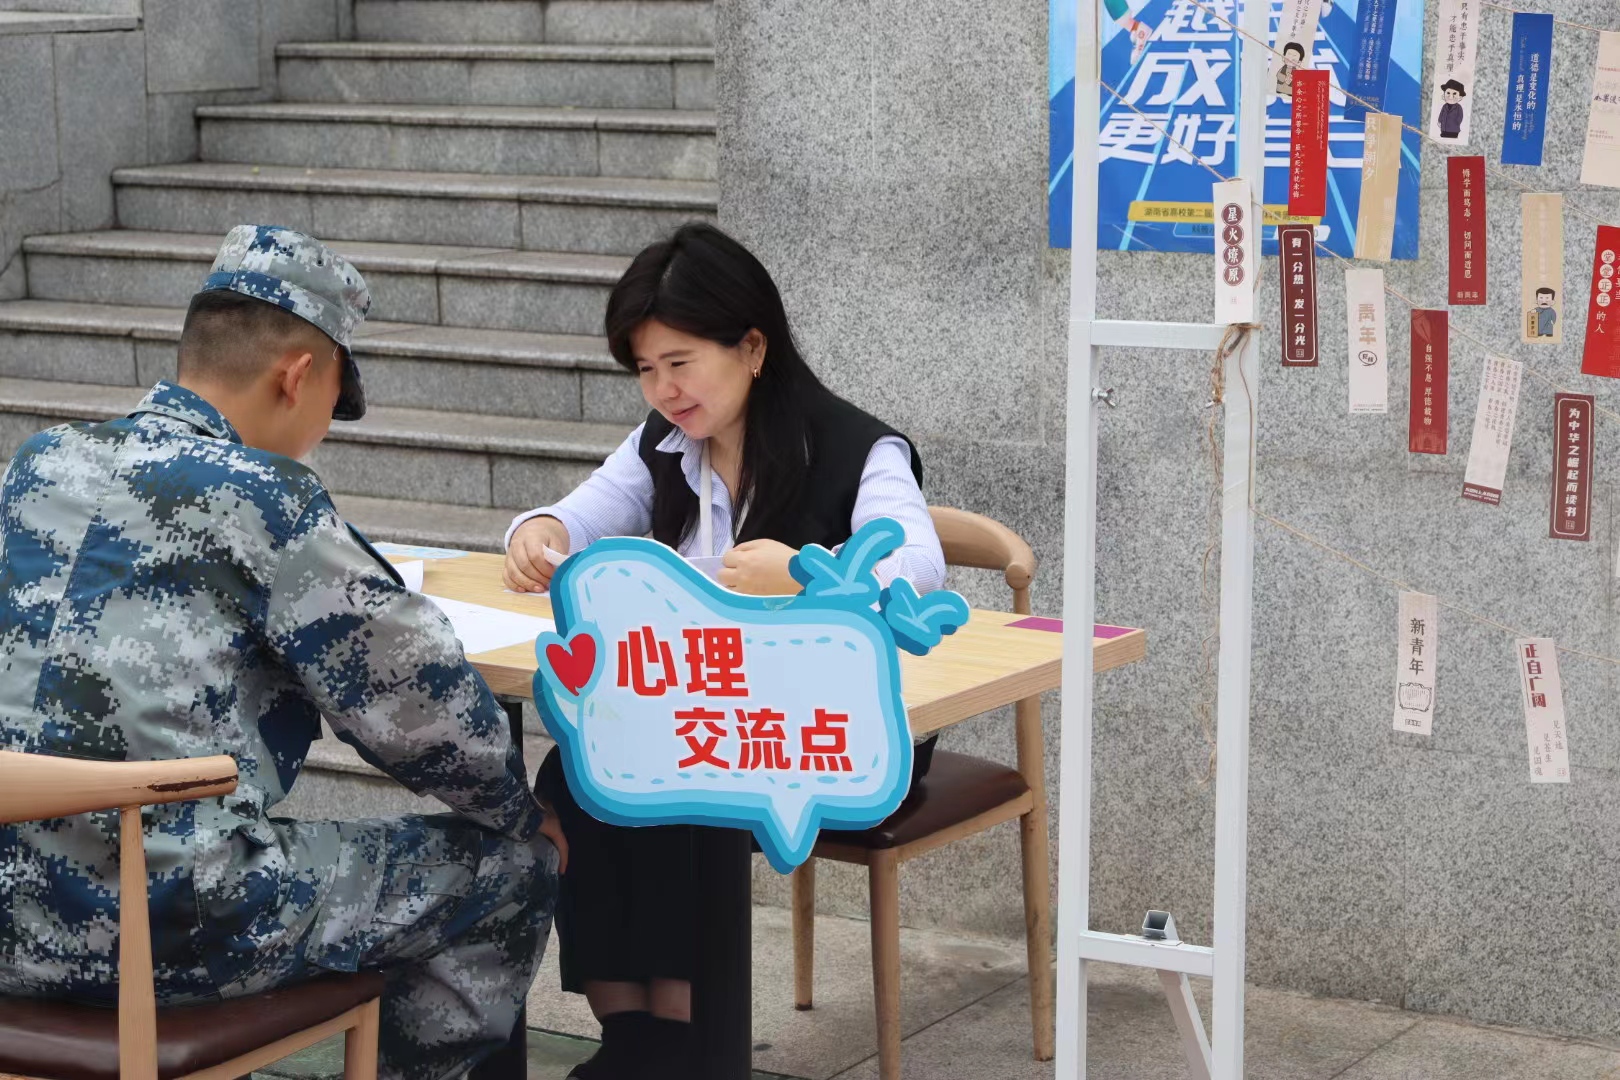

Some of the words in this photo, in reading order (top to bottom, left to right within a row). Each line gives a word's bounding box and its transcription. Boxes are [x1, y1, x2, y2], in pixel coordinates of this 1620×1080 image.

[1512, 74, 1525, 131] 真理是永恒的
[1526, 53, 1539, 110] 道德是变化的
[1594, 91, 1620, 105] 如果没
[1224, 204, 1243, 283] 星火燎原
[1594, 250, 1614, 334] 堂堂正正的人
[1564, 407, 1581, 518] 为中华之崛起而读书
[616, 625, 749, 698] 心理
[1408, 617, 1425, 676] 新青年
[674, 707, 853, 772] 交流点
